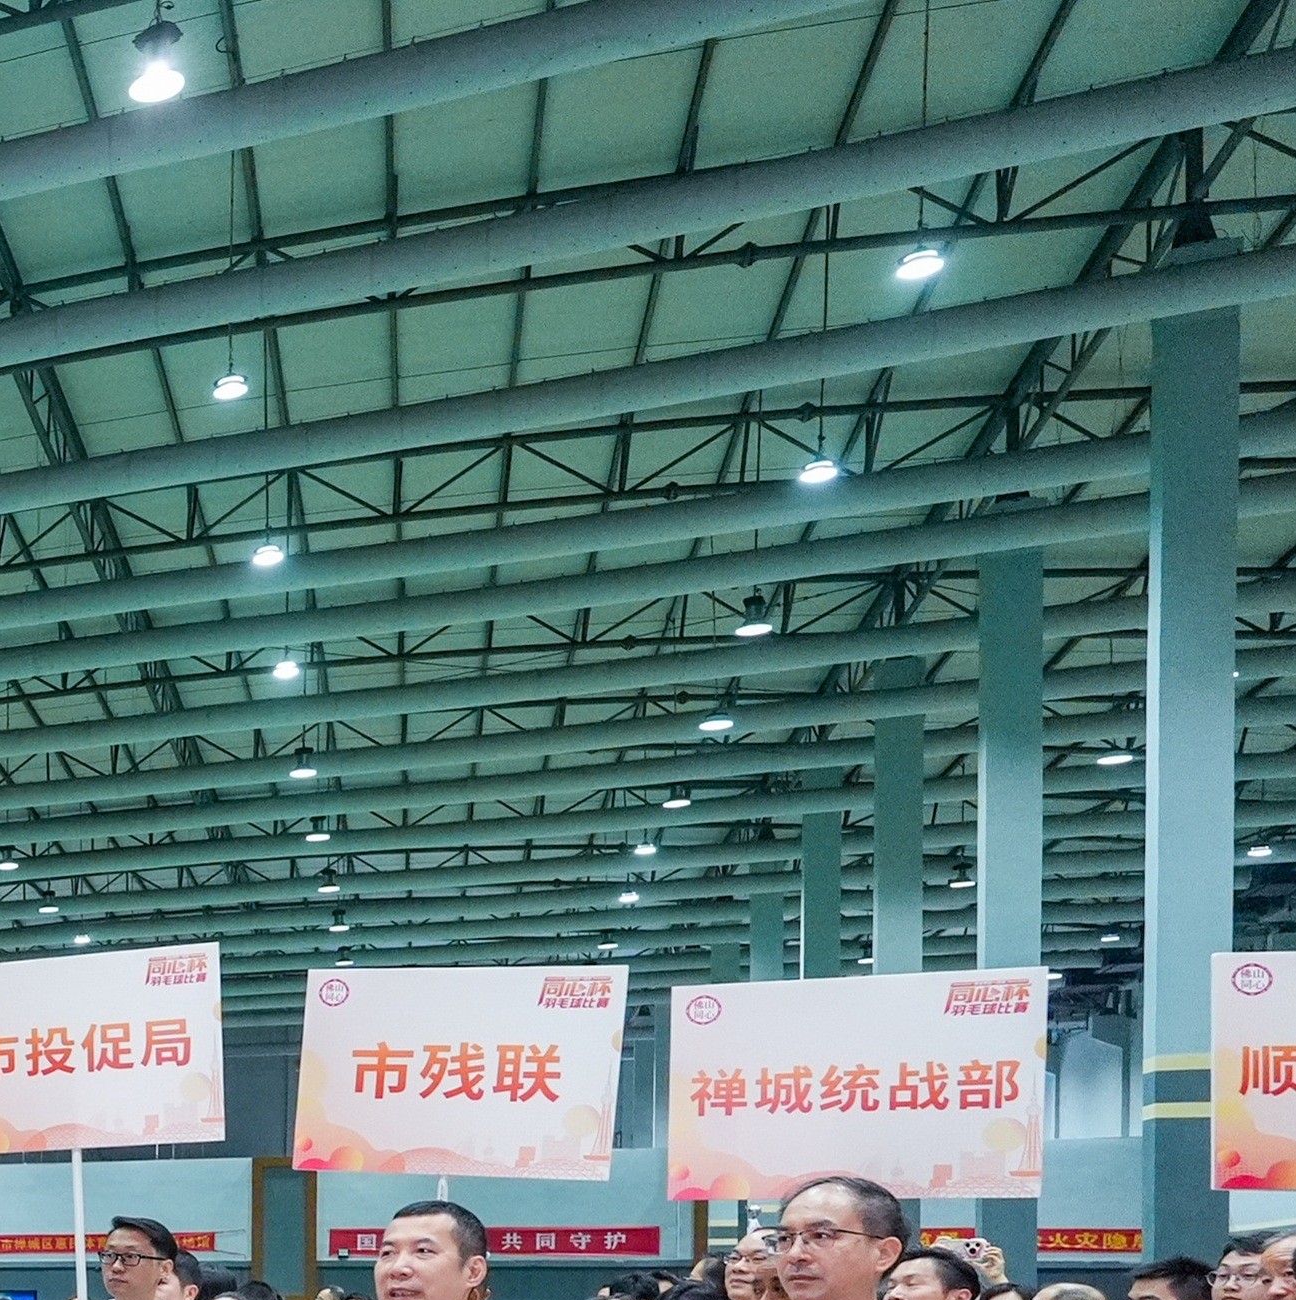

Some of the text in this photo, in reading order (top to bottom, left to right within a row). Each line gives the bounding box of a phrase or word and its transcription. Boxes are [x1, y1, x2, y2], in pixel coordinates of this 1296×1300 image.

[352, 1041, 561, 1103] 市残联
[689, 1058, 1021, 1118] 禅城统战部
[502, 1232, 627, 1250] 共同守护
[1037, 1233, 1143, 1249] 火灾隐
